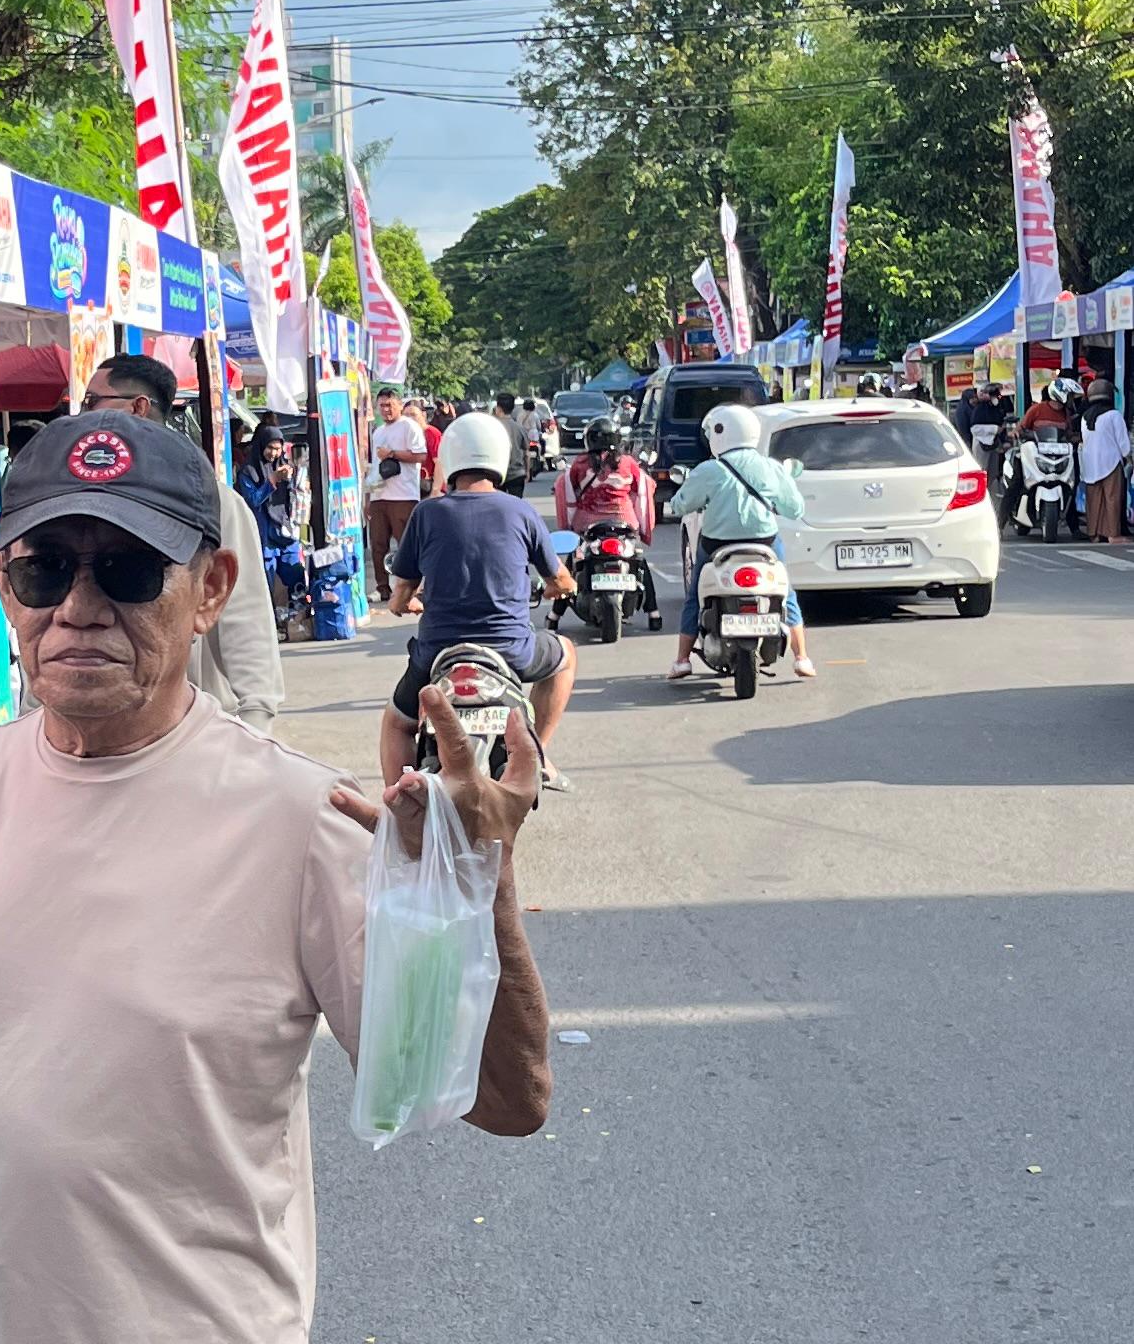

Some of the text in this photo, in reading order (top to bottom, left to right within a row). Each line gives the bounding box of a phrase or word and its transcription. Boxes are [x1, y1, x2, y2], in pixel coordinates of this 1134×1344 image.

[72, 433, 130, 458] LACOSTE
[840, 547, 855, 560] DD
[861, 545, 889, 560] 1925
